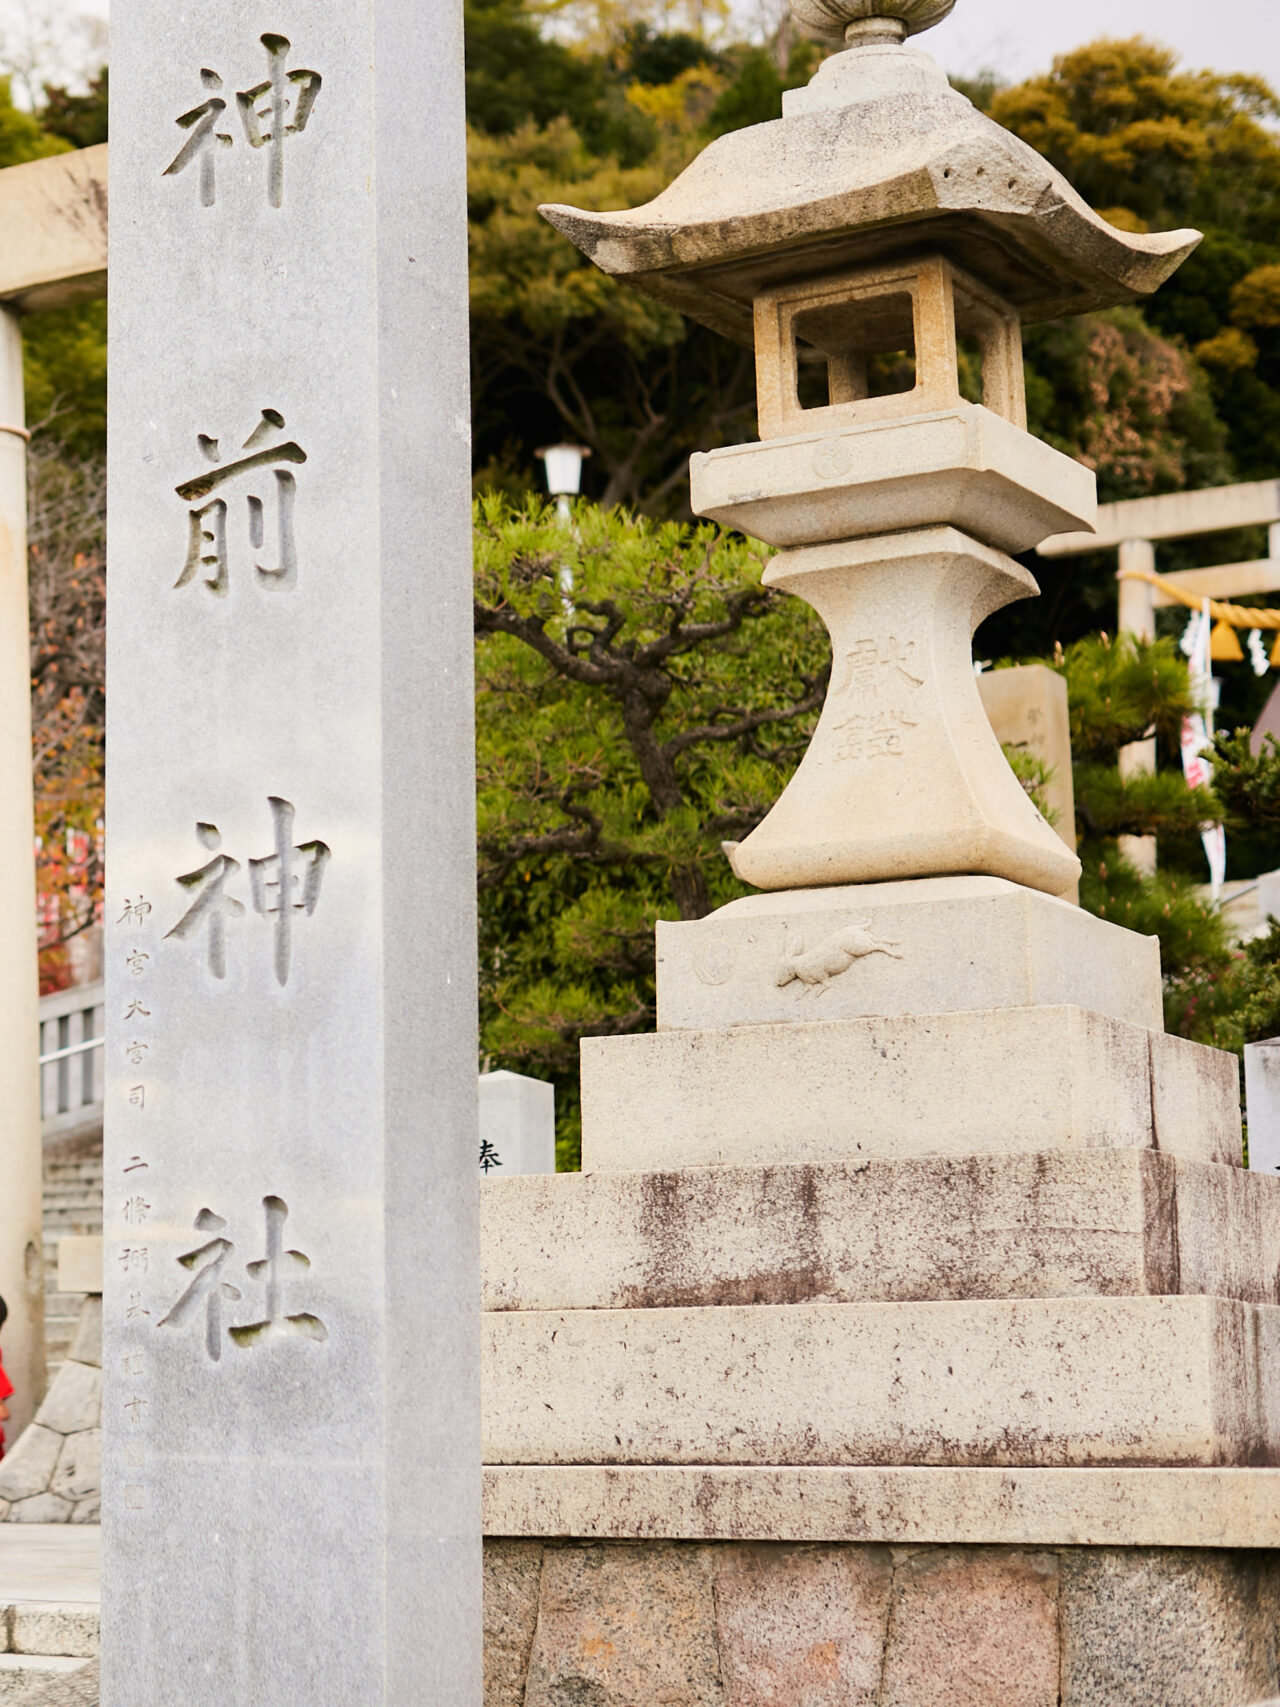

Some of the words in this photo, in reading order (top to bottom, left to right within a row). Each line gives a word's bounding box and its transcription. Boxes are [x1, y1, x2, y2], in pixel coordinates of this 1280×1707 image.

[116, 894, 152, 1112] 神宮大宮司
[157, 33, 332, 1363] 神前神社
